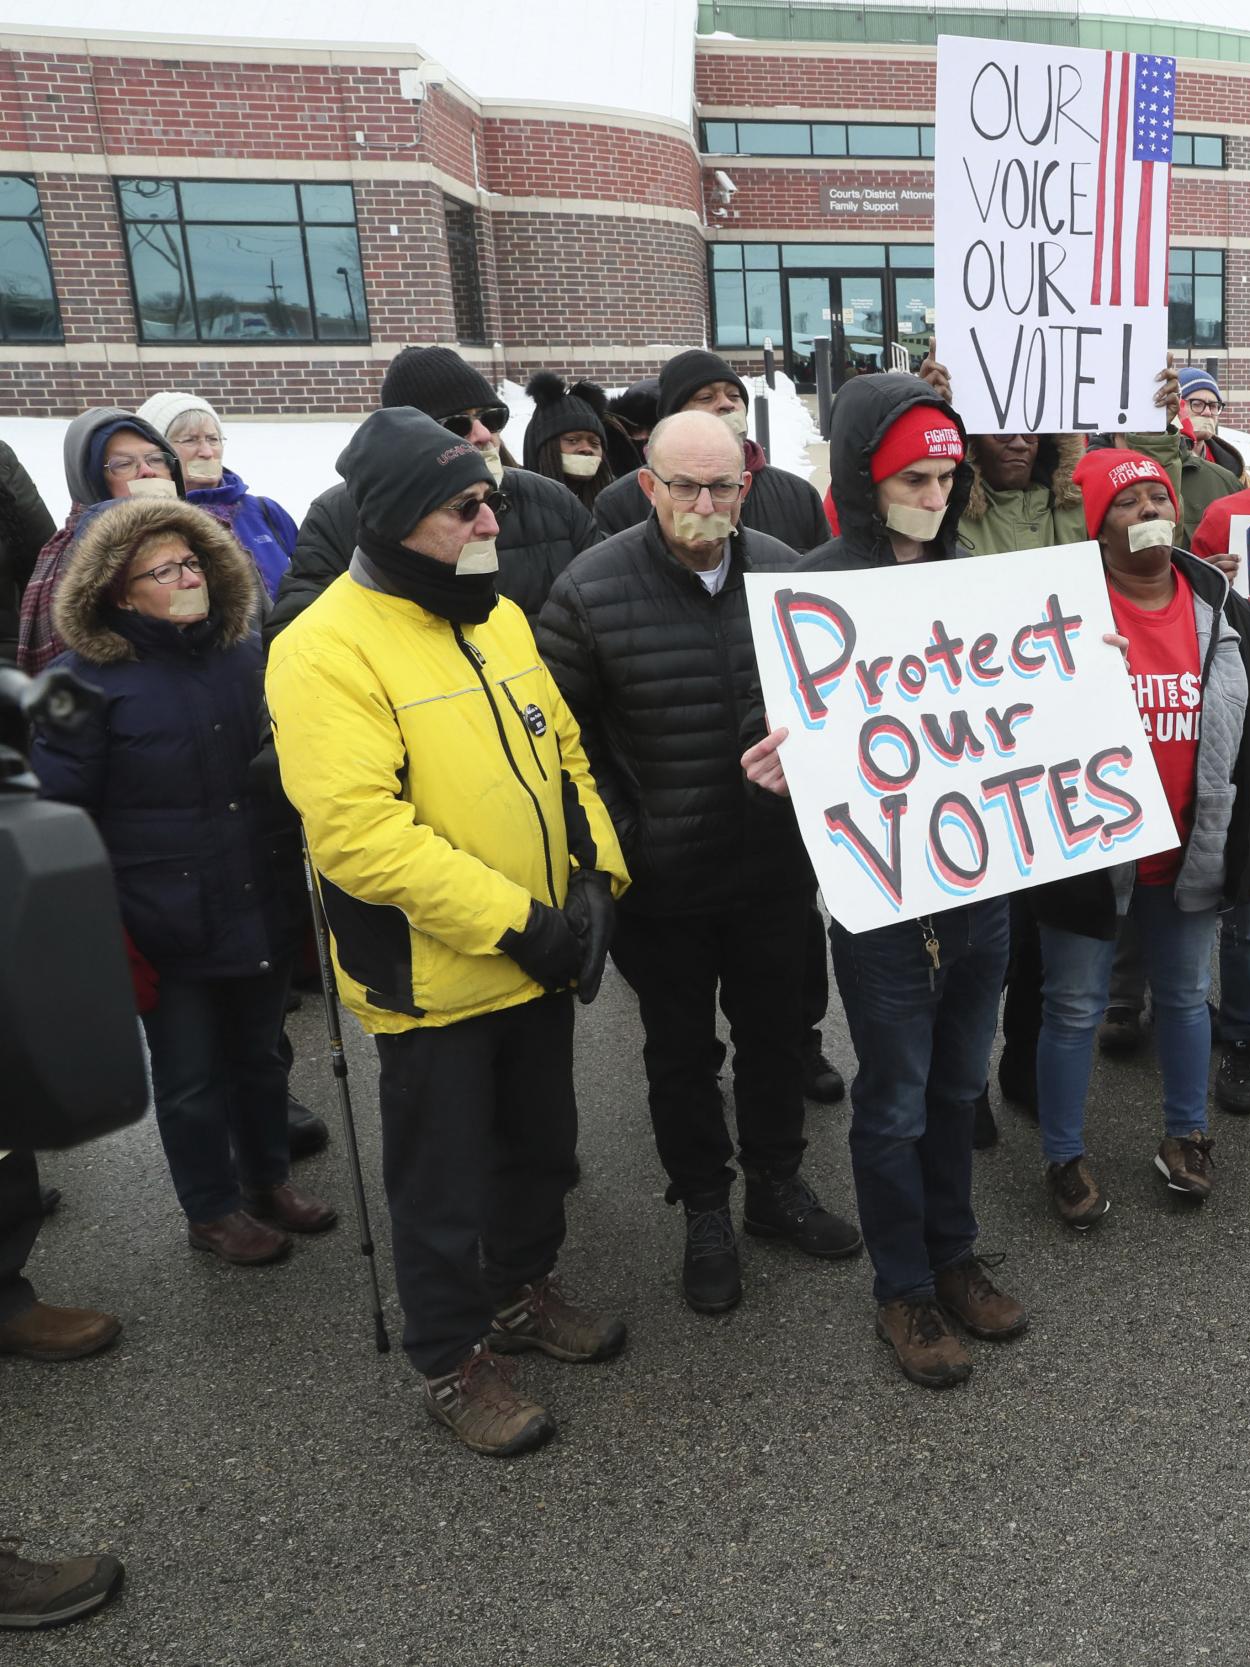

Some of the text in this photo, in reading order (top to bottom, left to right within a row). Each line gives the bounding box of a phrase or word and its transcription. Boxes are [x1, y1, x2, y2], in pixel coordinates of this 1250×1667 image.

[971, 61, 1099, 146] OUR
[829, 188, 896, 200] Courts/District
[830, 201, 899, 212] Family Support
[963, 156, 1093, 235] VOICE
[963, 239, 1076, 317] OUR
[969, 323, 1132, 432] VOTE!
[1108, 462, 1131, 478] FIGHT
[1112, 469, 1137, 488] FOR
[772, 588, 1082, 730] Protect
[1167, 681, 1180, 707] FOR
[824, 745, 1144, 912] VOTES
